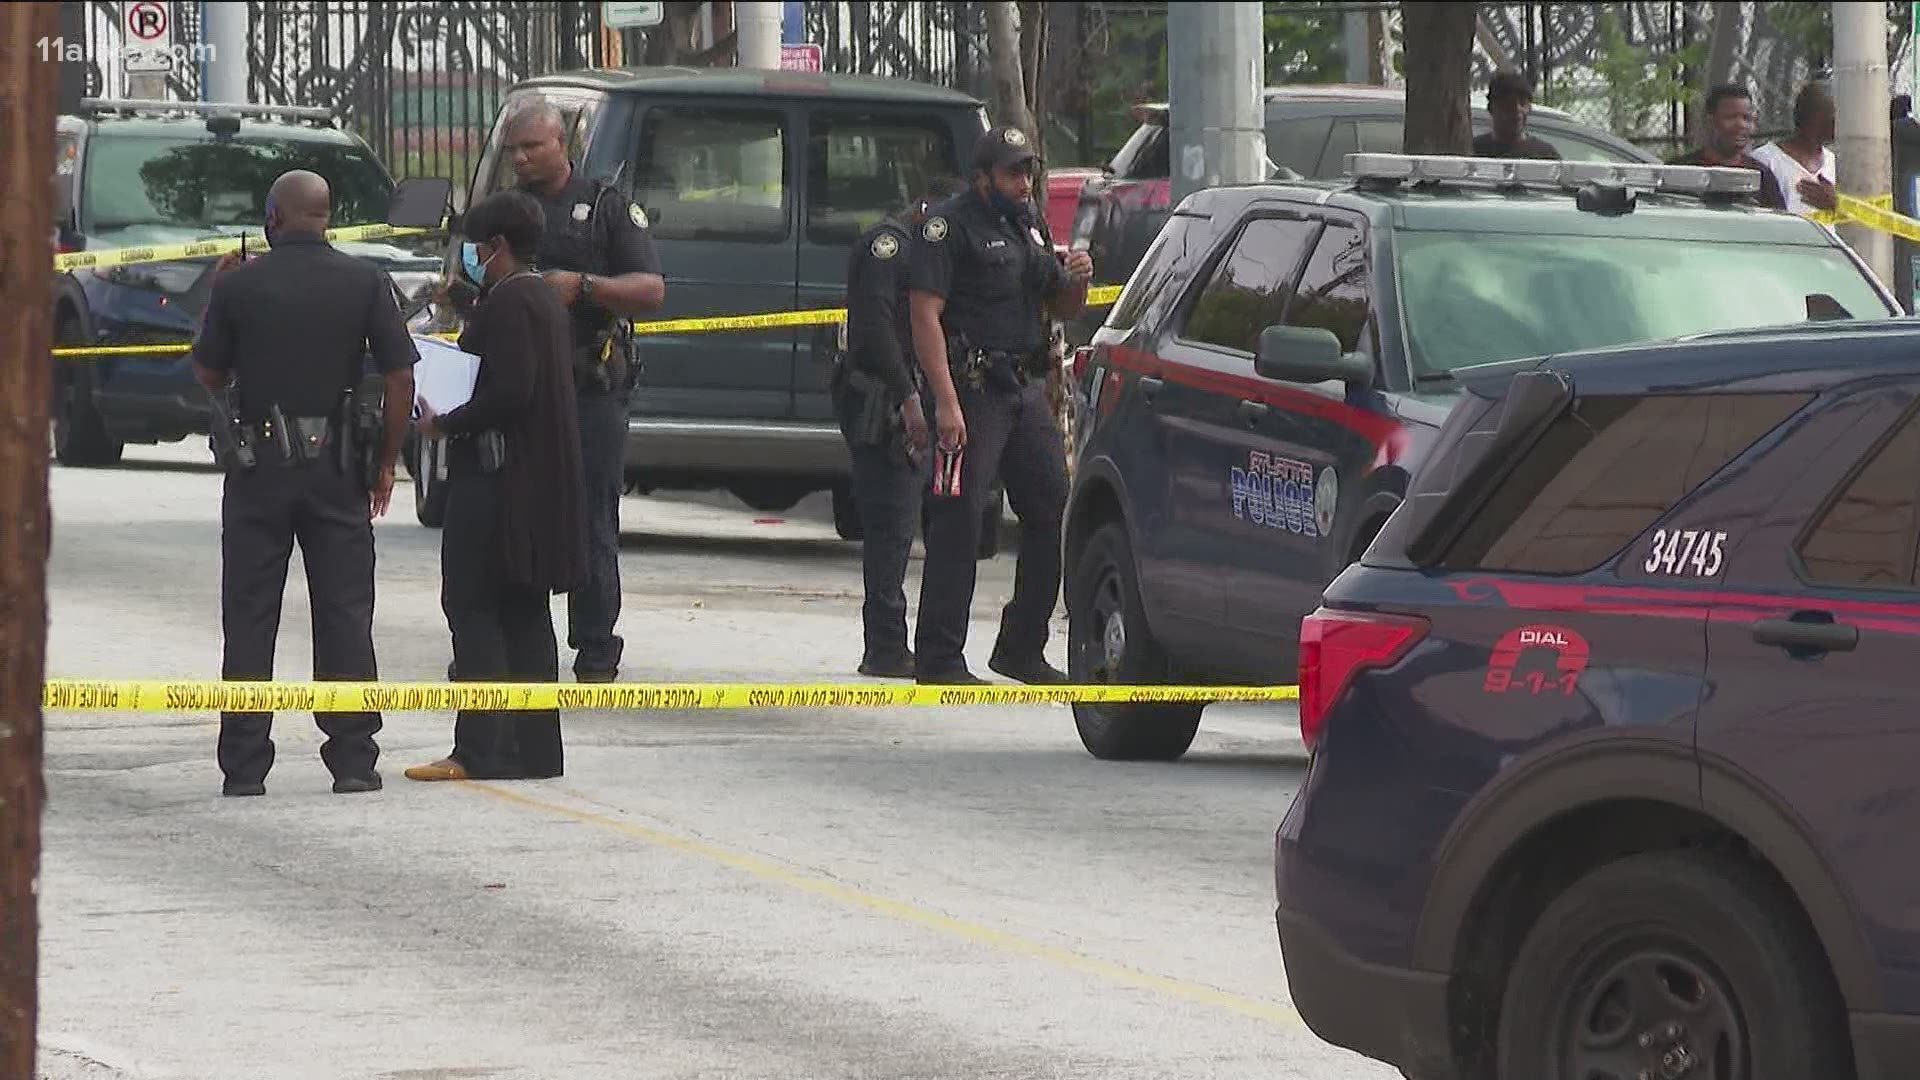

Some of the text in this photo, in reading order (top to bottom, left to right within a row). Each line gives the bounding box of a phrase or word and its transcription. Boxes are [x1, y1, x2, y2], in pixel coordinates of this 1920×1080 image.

[1231, 465, 1317, 537] POLICE
[1645, 529, 1727, 577] 34745
[1519, 630, 1569, 645] DIAL
[1483, 669, 1579, 696] 9-1-1
